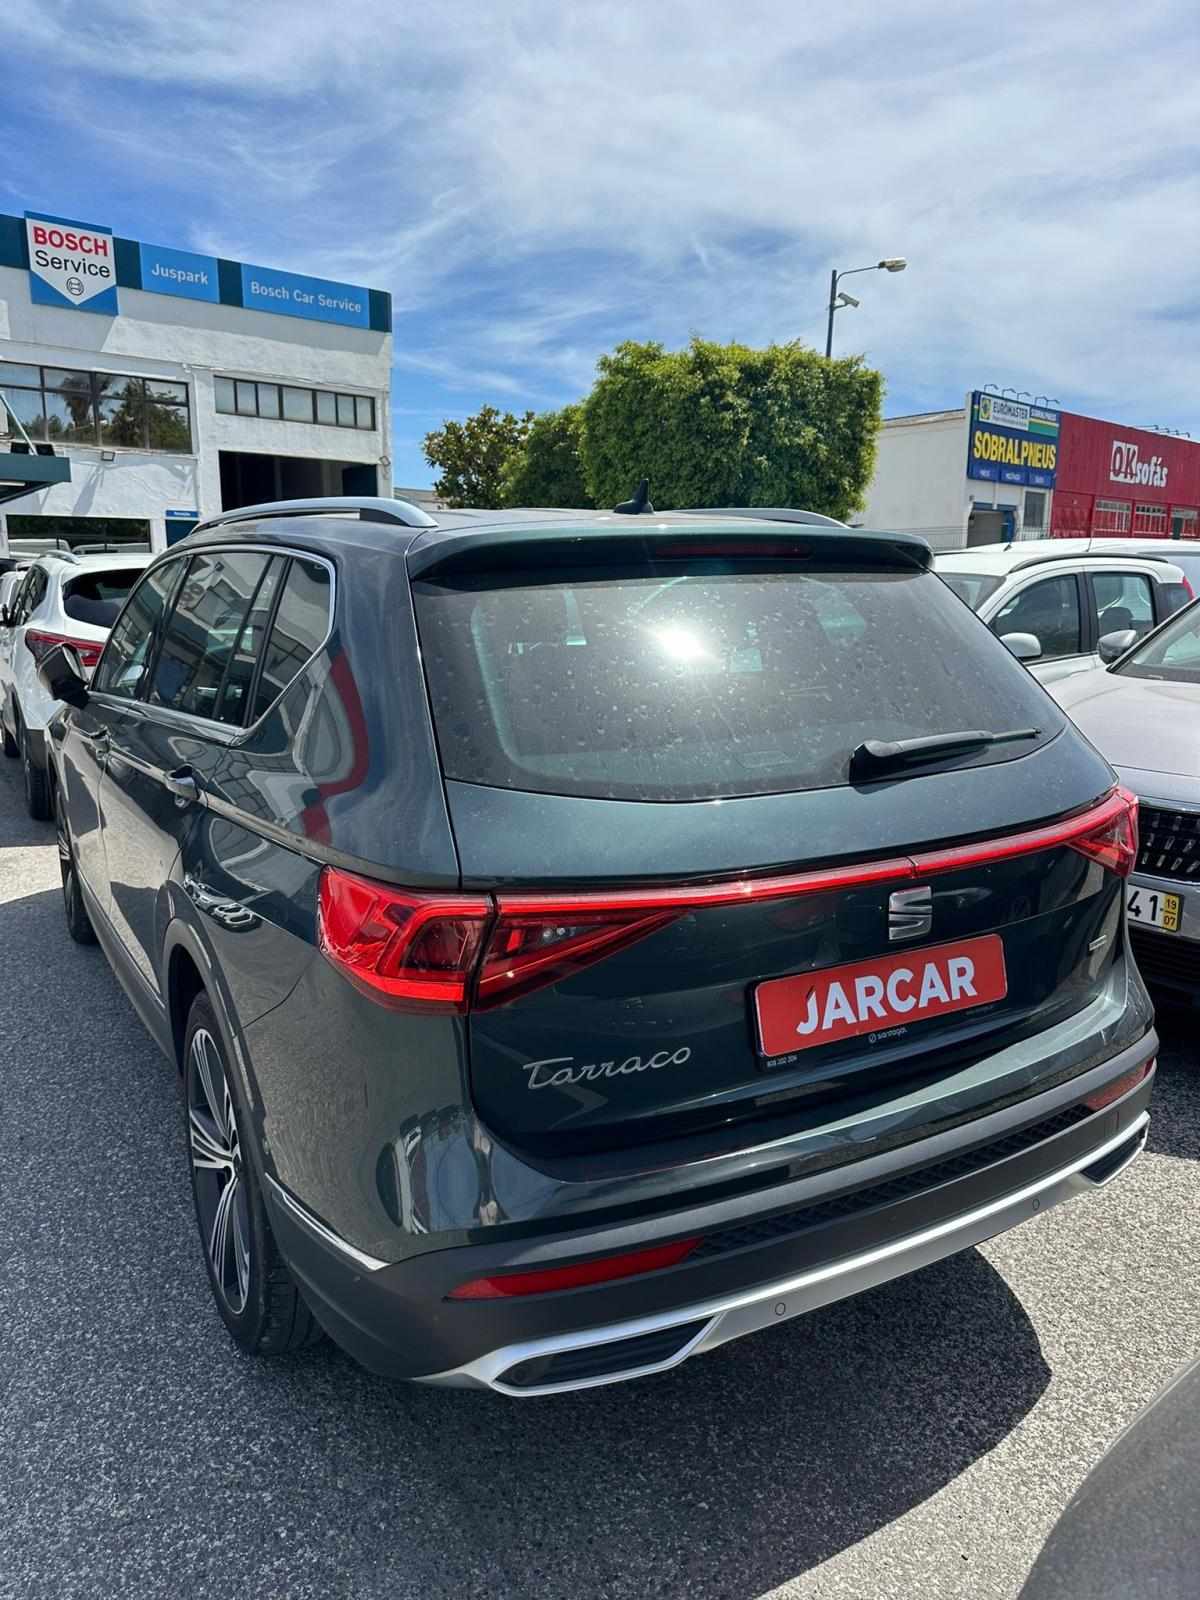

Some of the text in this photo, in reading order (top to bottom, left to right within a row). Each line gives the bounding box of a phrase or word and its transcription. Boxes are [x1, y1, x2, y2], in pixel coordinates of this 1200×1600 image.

[33, 226, 108, 257] BOSCH
[35, 249, 111, 278] Service
[151, 263, 209, 287] Juspark
[250, 281, 363, 313] Bosch Car Service
[1166, 898, 1177, 910] 19
[1163, 914, 1176, 926] 07
[796, 956, 978, 1035] JARCAR
[522, 1046, 692, 1090] Tarraco
